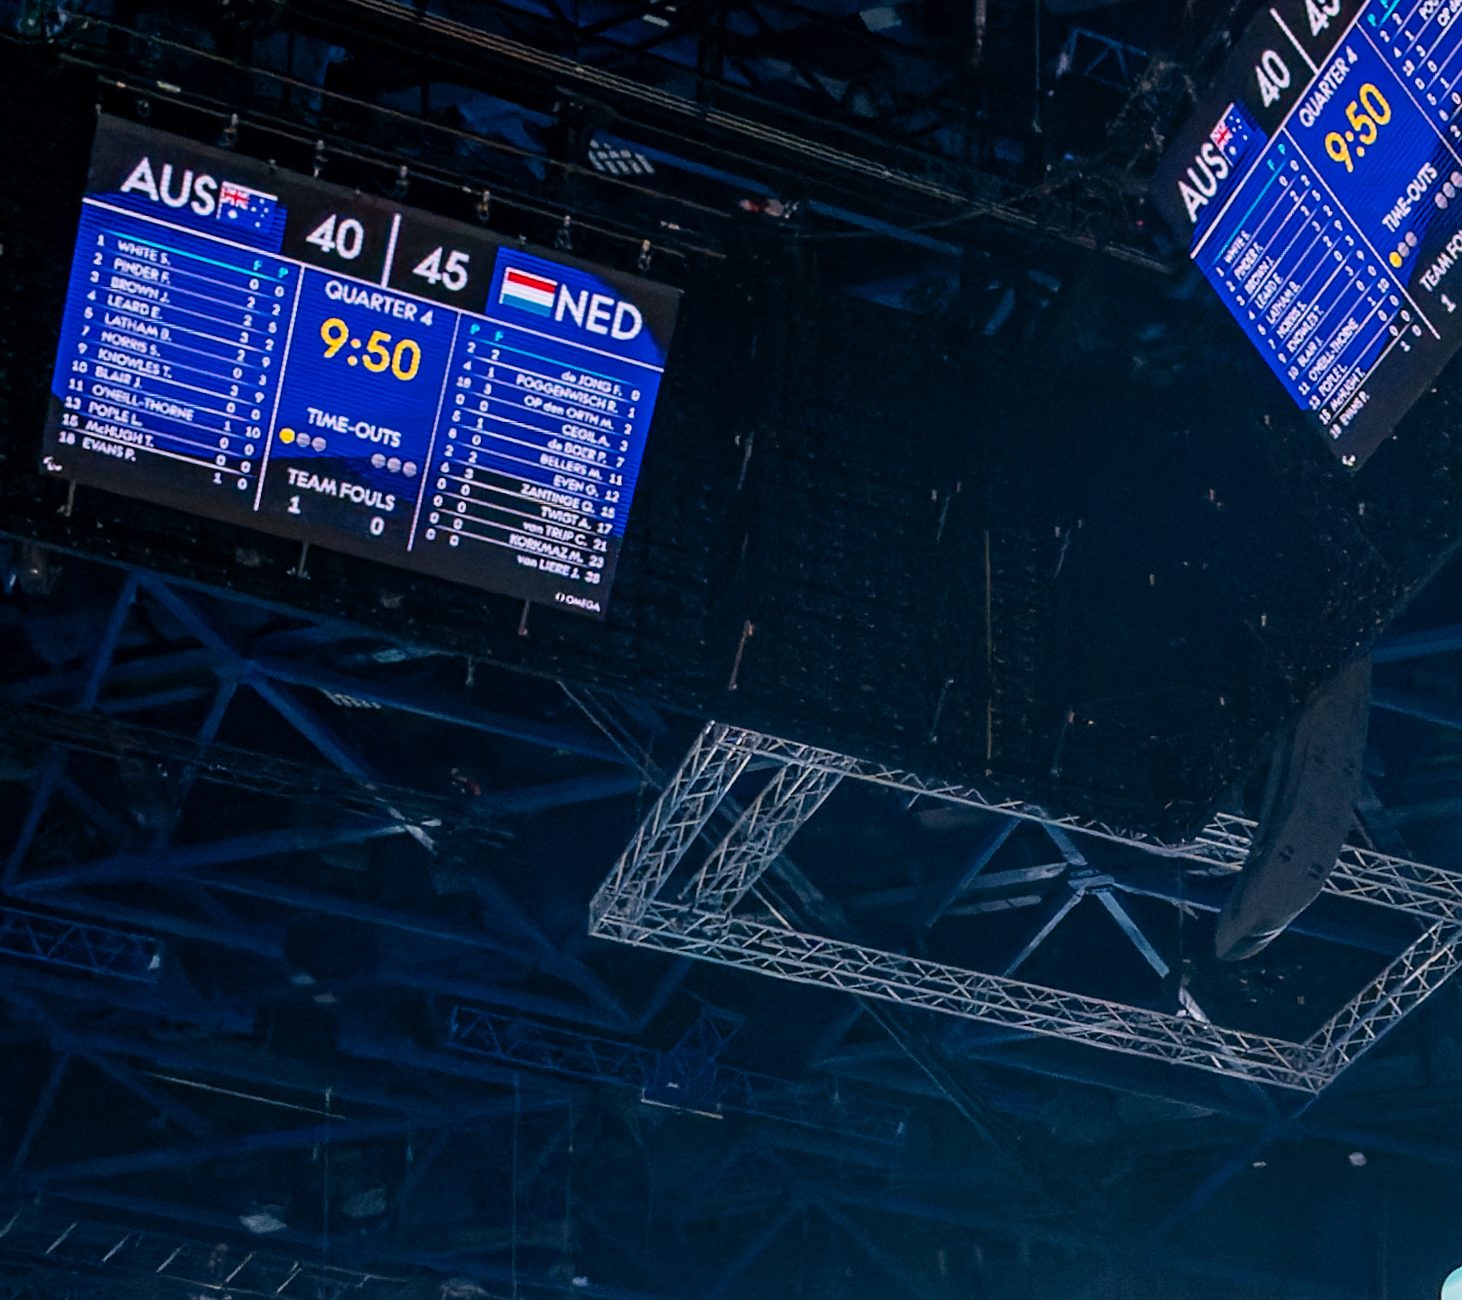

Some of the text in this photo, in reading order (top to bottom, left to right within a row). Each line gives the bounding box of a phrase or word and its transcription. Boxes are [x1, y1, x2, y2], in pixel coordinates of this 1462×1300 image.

[1255, 49, 1291, 108] 40
[1299, 57, 1351, 128] QUARTER
[1324, 83, 1392, 173] 9:50
[119, 155, 218, 217] AUS
[1177, 142, 1229, 223] AUS
[1381, 162, 1438, 233] TIME-OUTS
[117, 239, 159, 261] WHITE
[306, 213, 365, 260] 40
[113, 257, 159, 282] PINDER
[412, 245, 470, 292] 45
[1419, 252, 1454, 292] TEAM
[110, 275, 159, 301] BROWN
[107, 294, 150, 318] LEARD
[324, 279, 434, 327] QUARTER 4
[554, 283, 643, 341] NED
[1440, 293, 1457, 314] 1
[104, 313, 159, 338] LATHAM
[101, 331, 148, 355] NORRIS
[319, 317, 422, 381] 9:50
[94, 365, 132, 386] BLAIR
[97, 348, 160, 376] KNOWLES
[88, 400, 130, 425] POPLE
[306, 405, 402, 448] TIME-OUTS
[81, 436, 124, 459] EVANS
[287, 467, 396, 512] TEAM FOULS
[552, 473, 584, 492] EVEN
[287, 495, 302, 515] 1
[370, 515, 385, 536] 0
[508, 533, 567, 559] KORKMAZ
